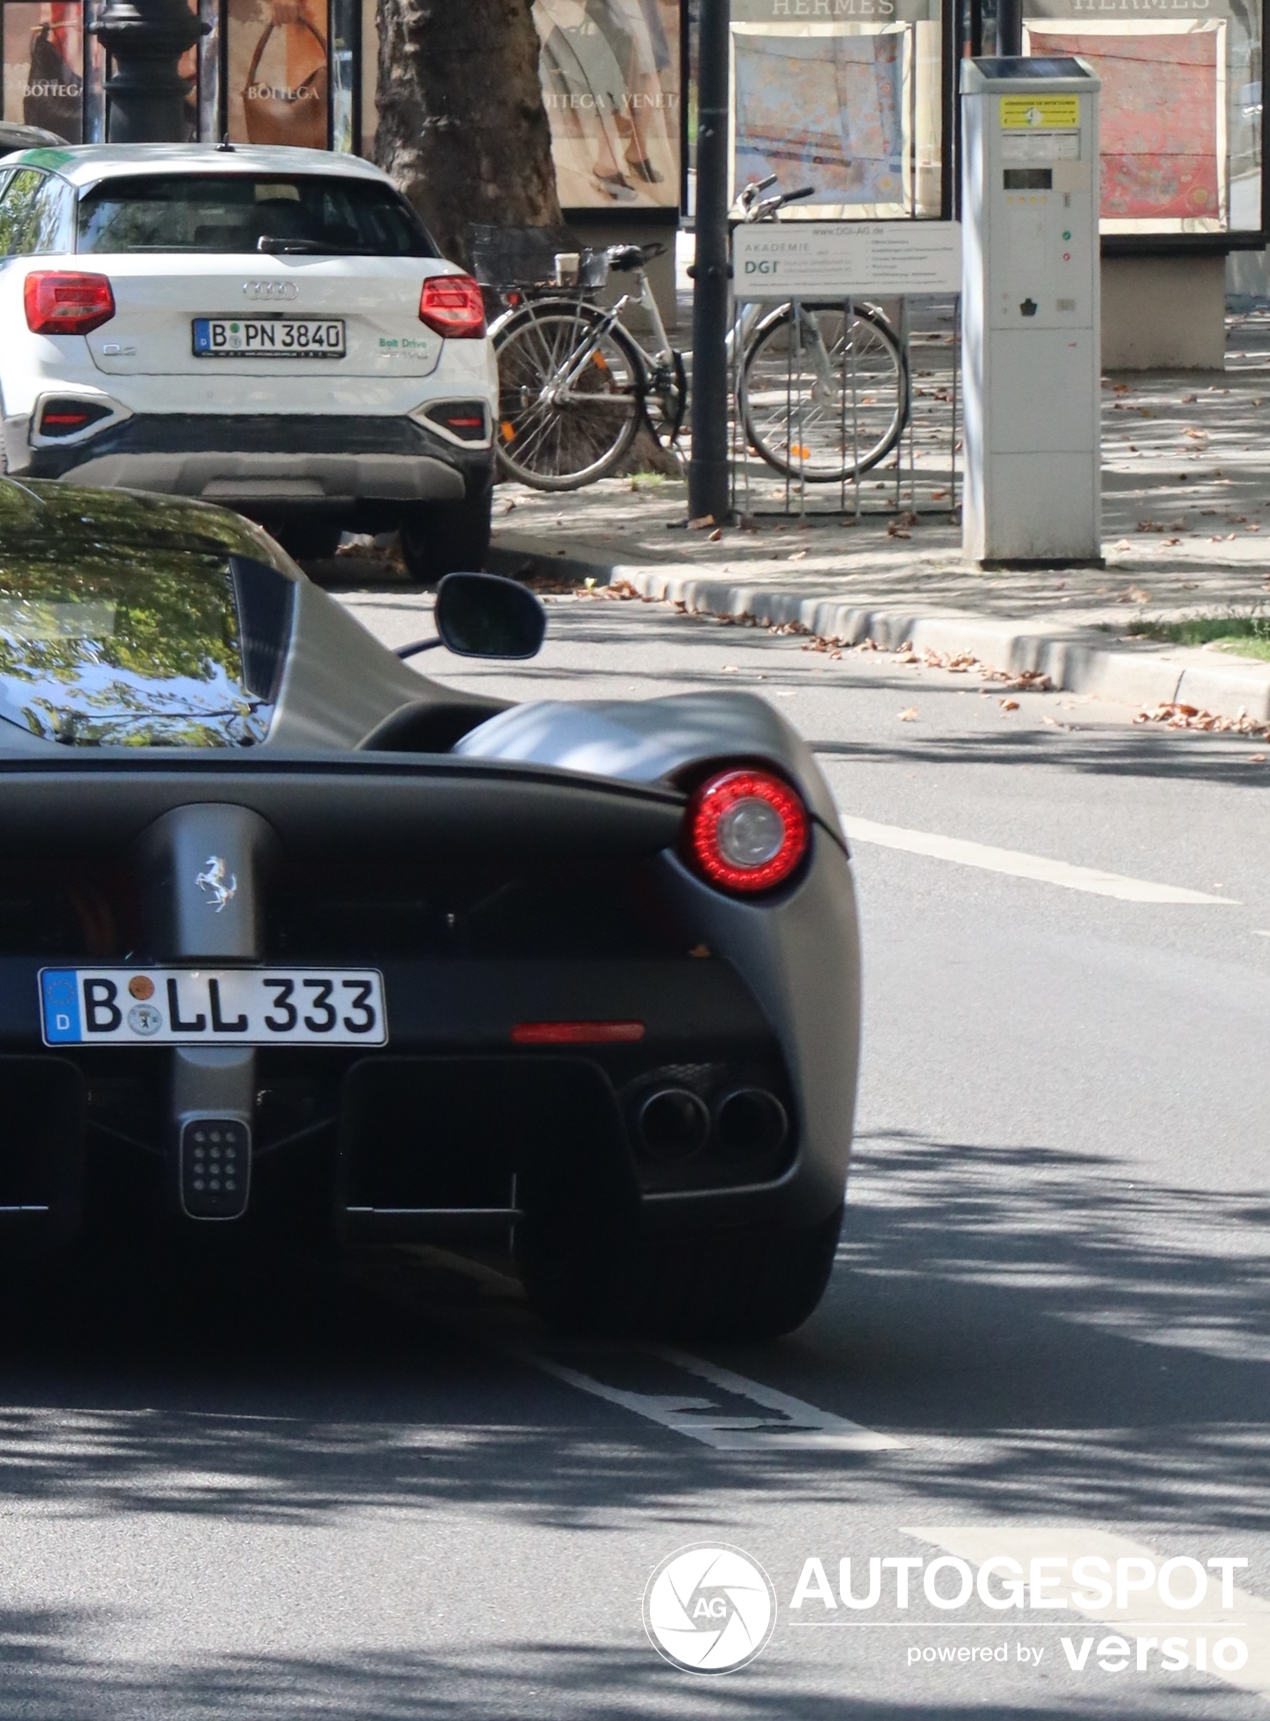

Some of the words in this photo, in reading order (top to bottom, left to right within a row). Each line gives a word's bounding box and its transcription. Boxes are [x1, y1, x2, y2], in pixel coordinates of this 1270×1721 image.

[247, 86, 320, 100] BOTTEGA
[745, 243, 809, 252] AKADEMIE
[200, 338, 207, 346] D
[212, 324, 227, 347] B
[244, 324, 276, 347] PN
[282, 324, 340, 348] 3840
[402, 338, 428, 349] Drive
[83, 978, 122, 1032] B
[167, 978, 249, 1032] LL
[262, 979, 376, 1033] 333
[56, 1014, 70, 1030] D
